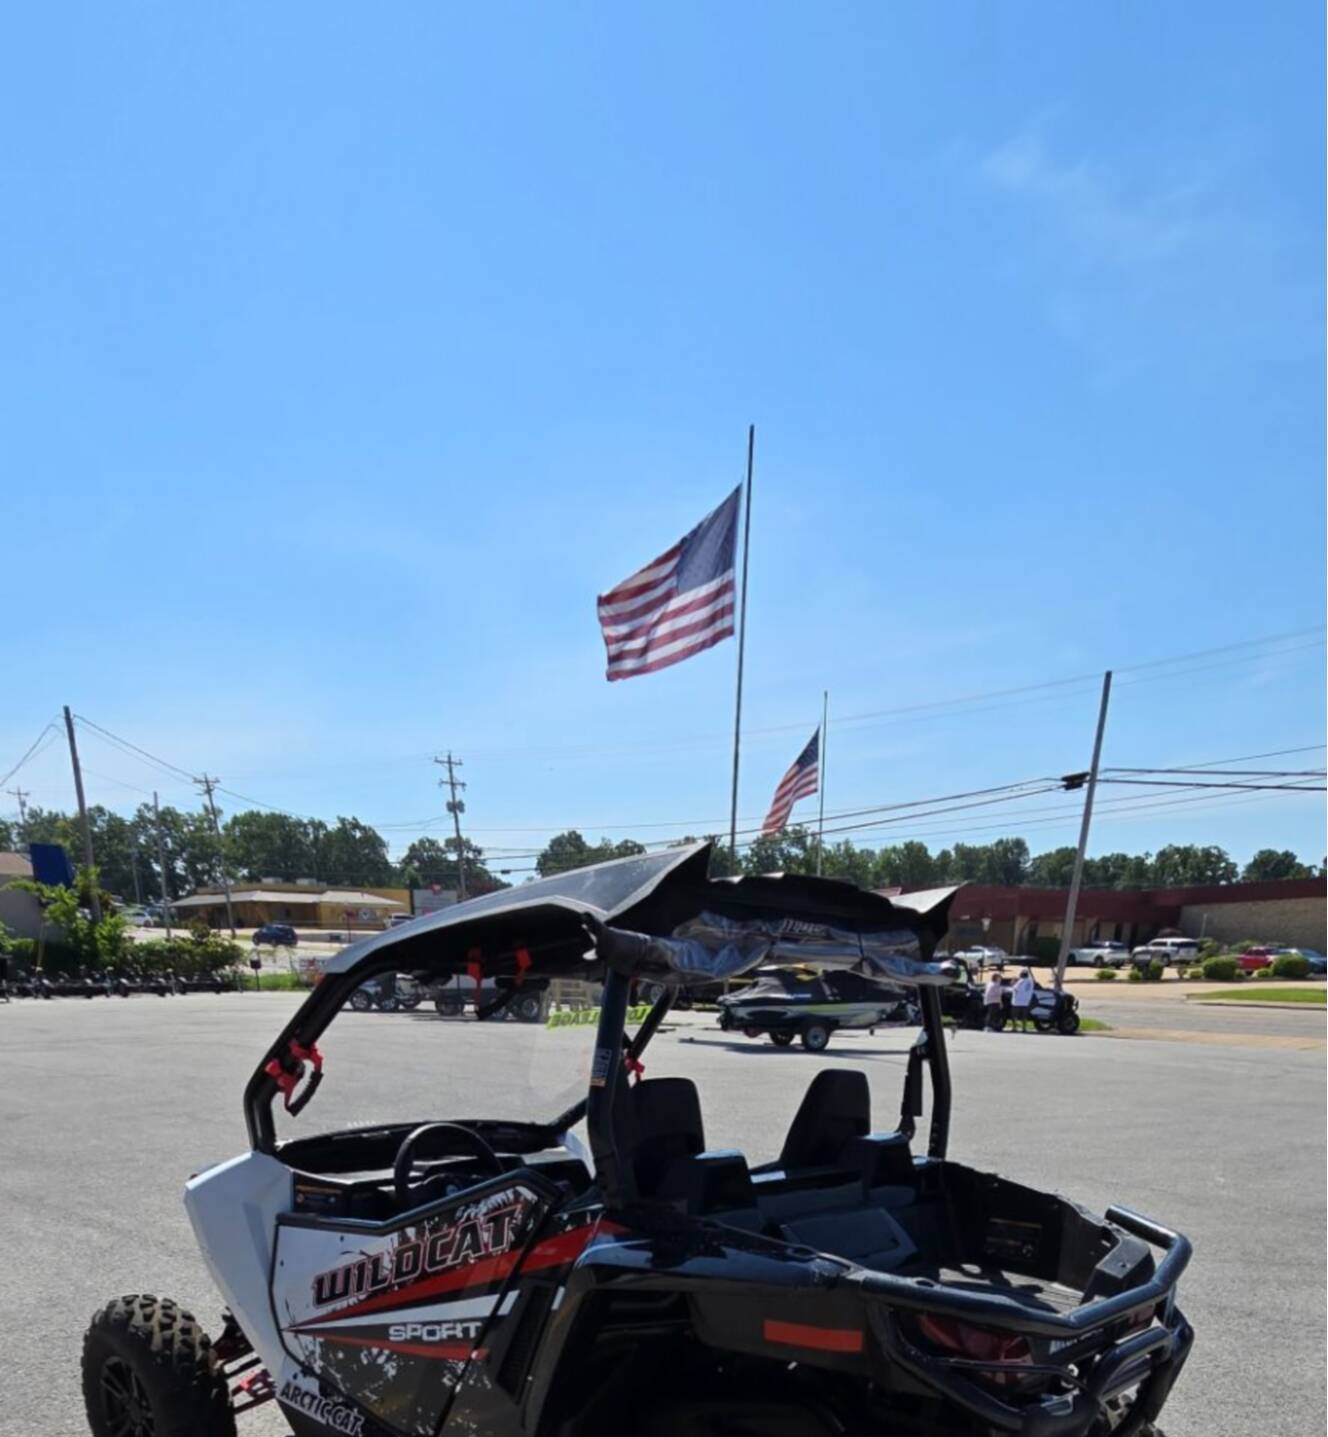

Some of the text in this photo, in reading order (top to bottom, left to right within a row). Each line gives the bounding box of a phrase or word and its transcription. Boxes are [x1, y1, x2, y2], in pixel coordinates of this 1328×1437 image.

[313, 1204, 521, 1308] WILDCAT
[389, 1322, 482, 1341] SPORT
[280, 1381, 364, 1435] ARCTIC CAT
